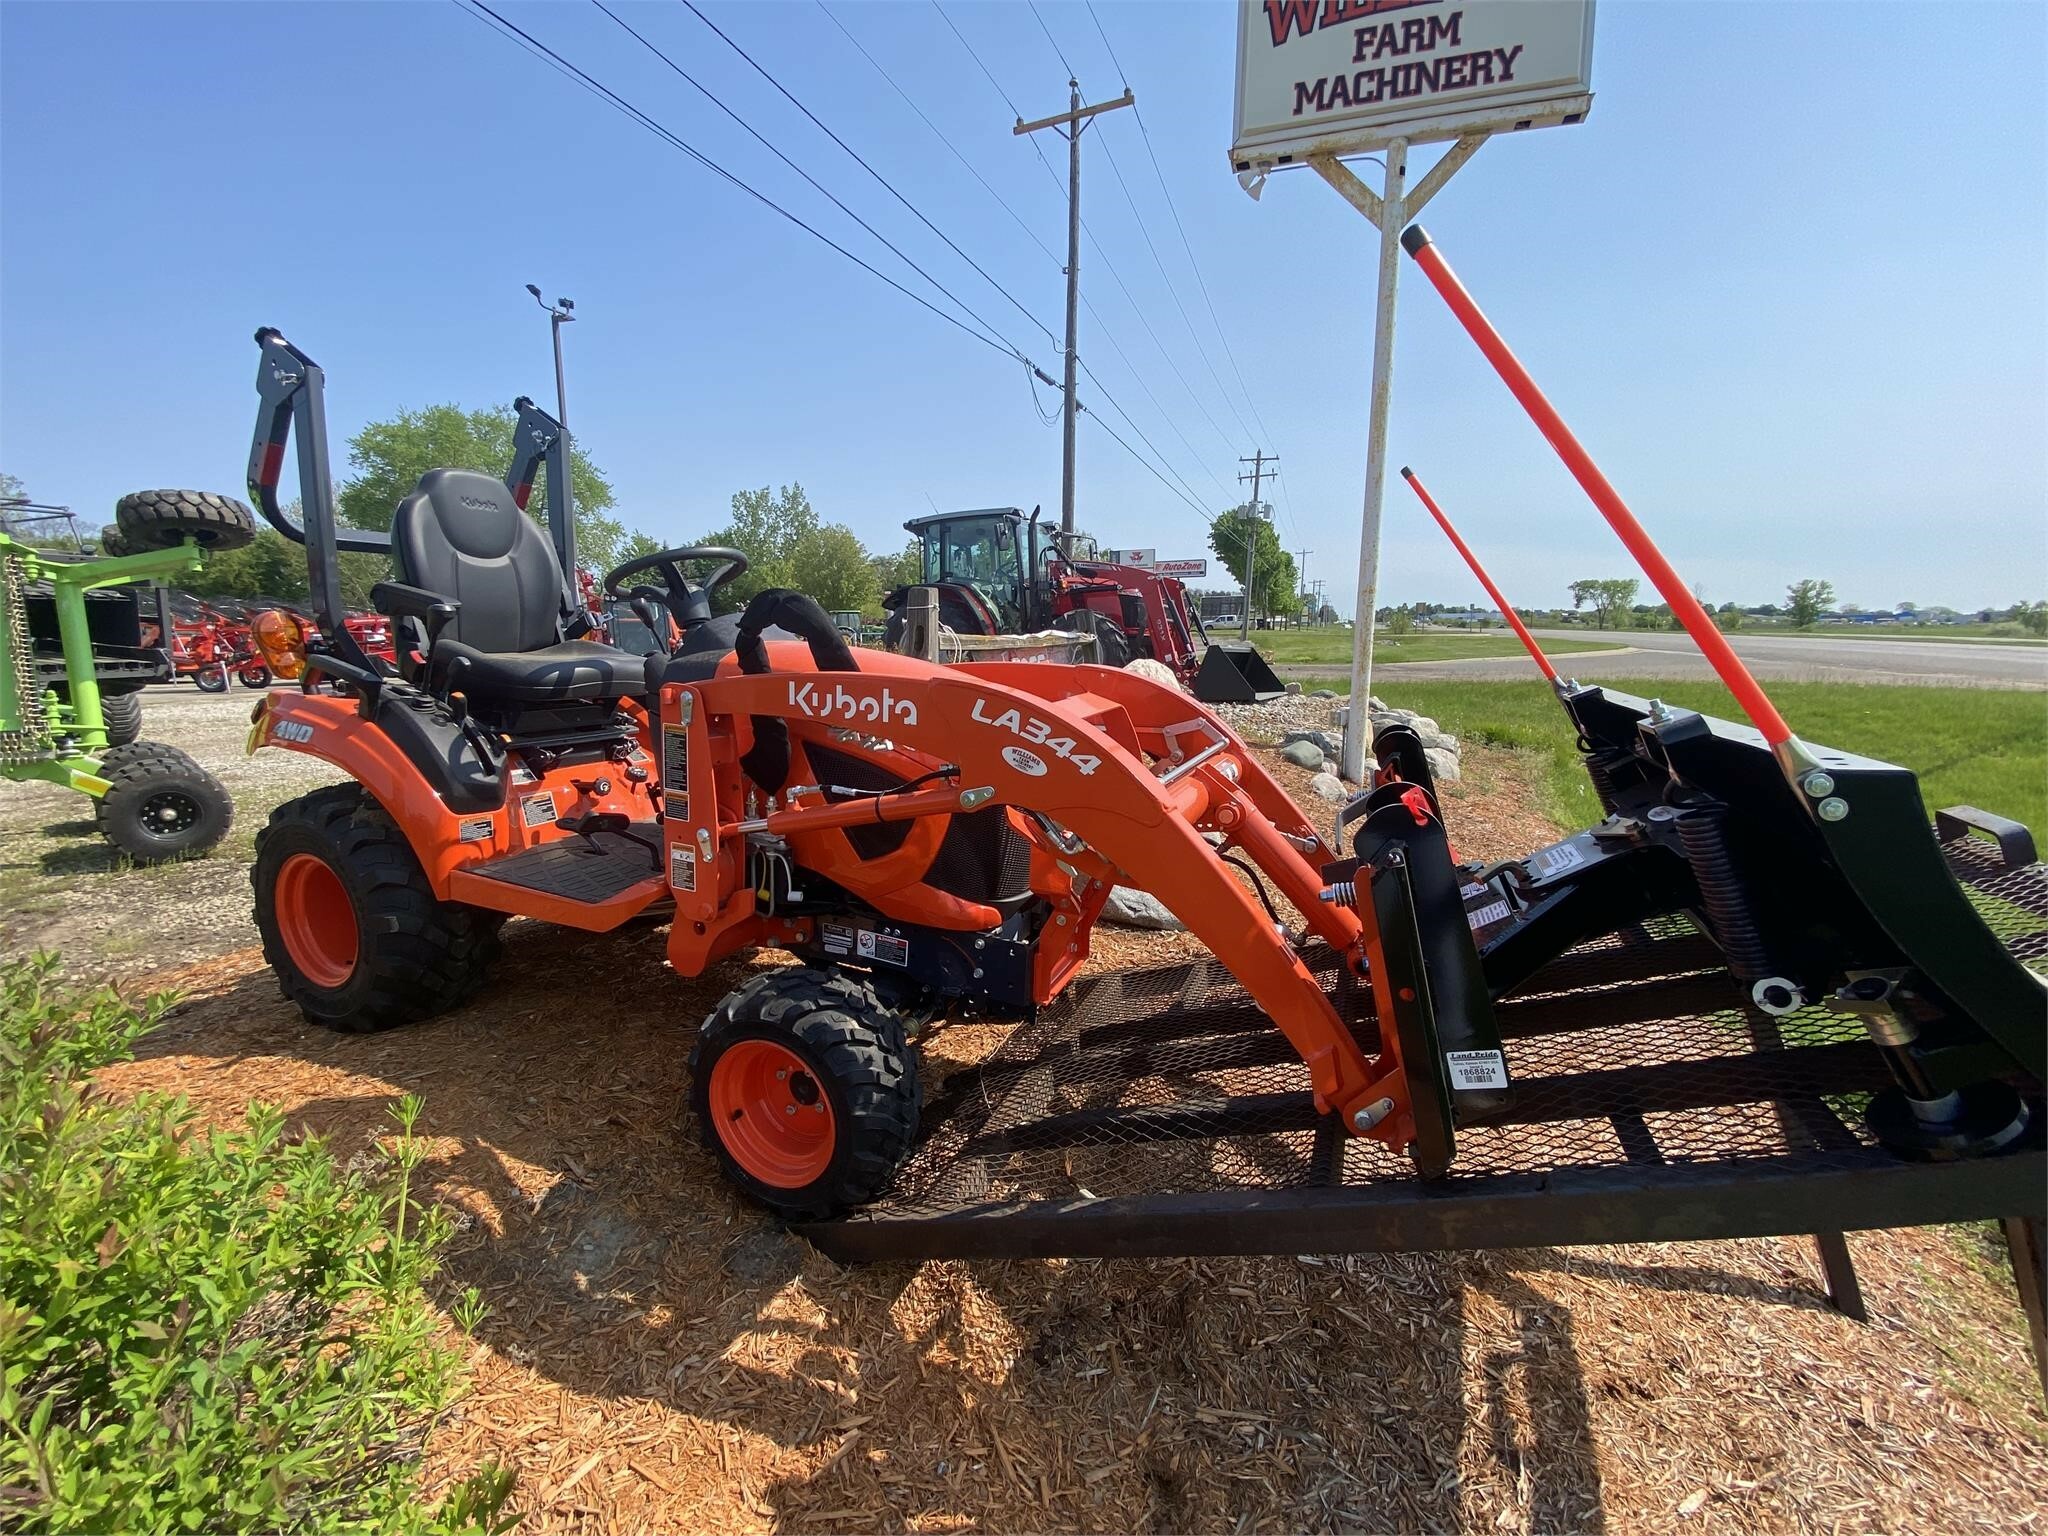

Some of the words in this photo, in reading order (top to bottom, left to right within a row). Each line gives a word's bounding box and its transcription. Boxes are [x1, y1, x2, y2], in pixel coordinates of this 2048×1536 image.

[1352, 11, 1463, 63] FARM
[1293, 45, 1523, 116] MACHINERY
[1163, 562, 1201, 571] AutoZone
[788, 681, 918, 725] Kubota
[273, 720, 314, 743] 4WD
[971, 699, 1102, 776] LA344
[1450, 1052, 1472, 1060] Land
[1474, 1051, 1499, 1059] Pride
[1458, 1068, 1496, 1076] 1868824
